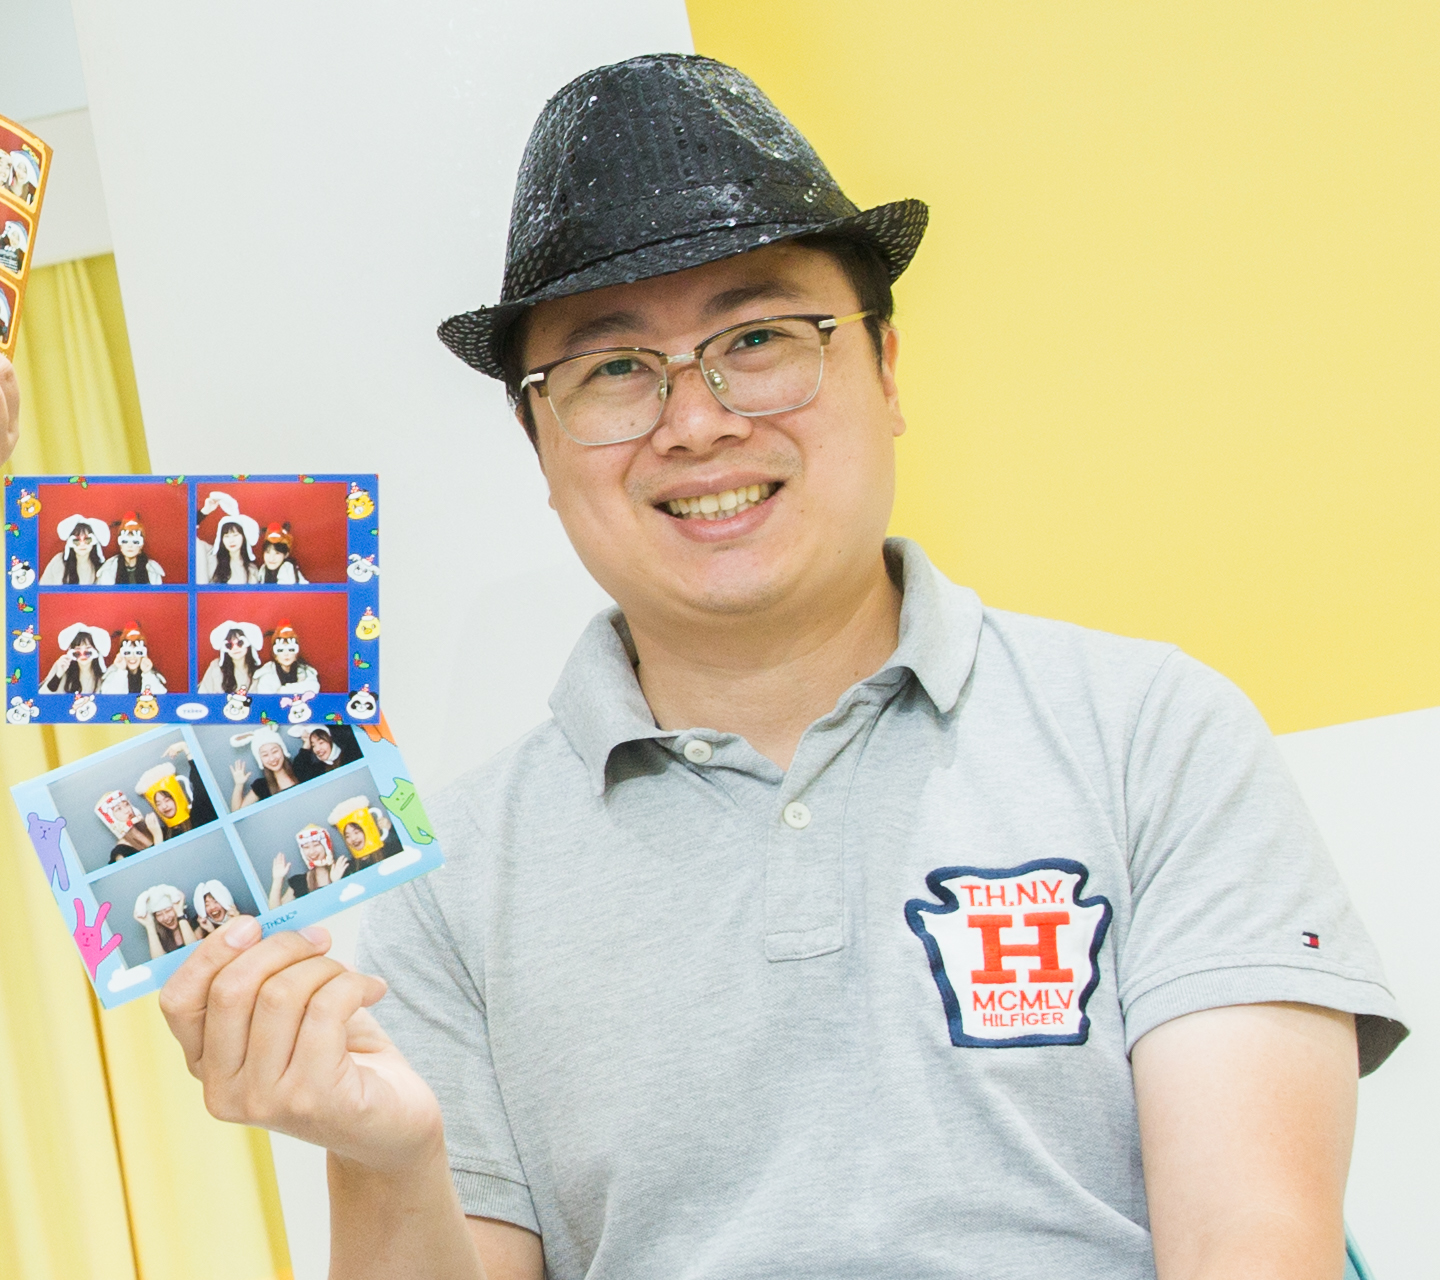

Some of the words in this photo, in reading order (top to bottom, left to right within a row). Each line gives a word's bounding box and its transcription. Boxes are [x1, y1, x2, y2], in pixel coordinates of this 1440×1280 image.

[960, 879, 1065, 907] T.H.N.Y.
[967, 911, 1074, 984] H
[972, 989, 1074, 1012] MCMLV
[982, 1012, 1064, 1027] HILFIGER
